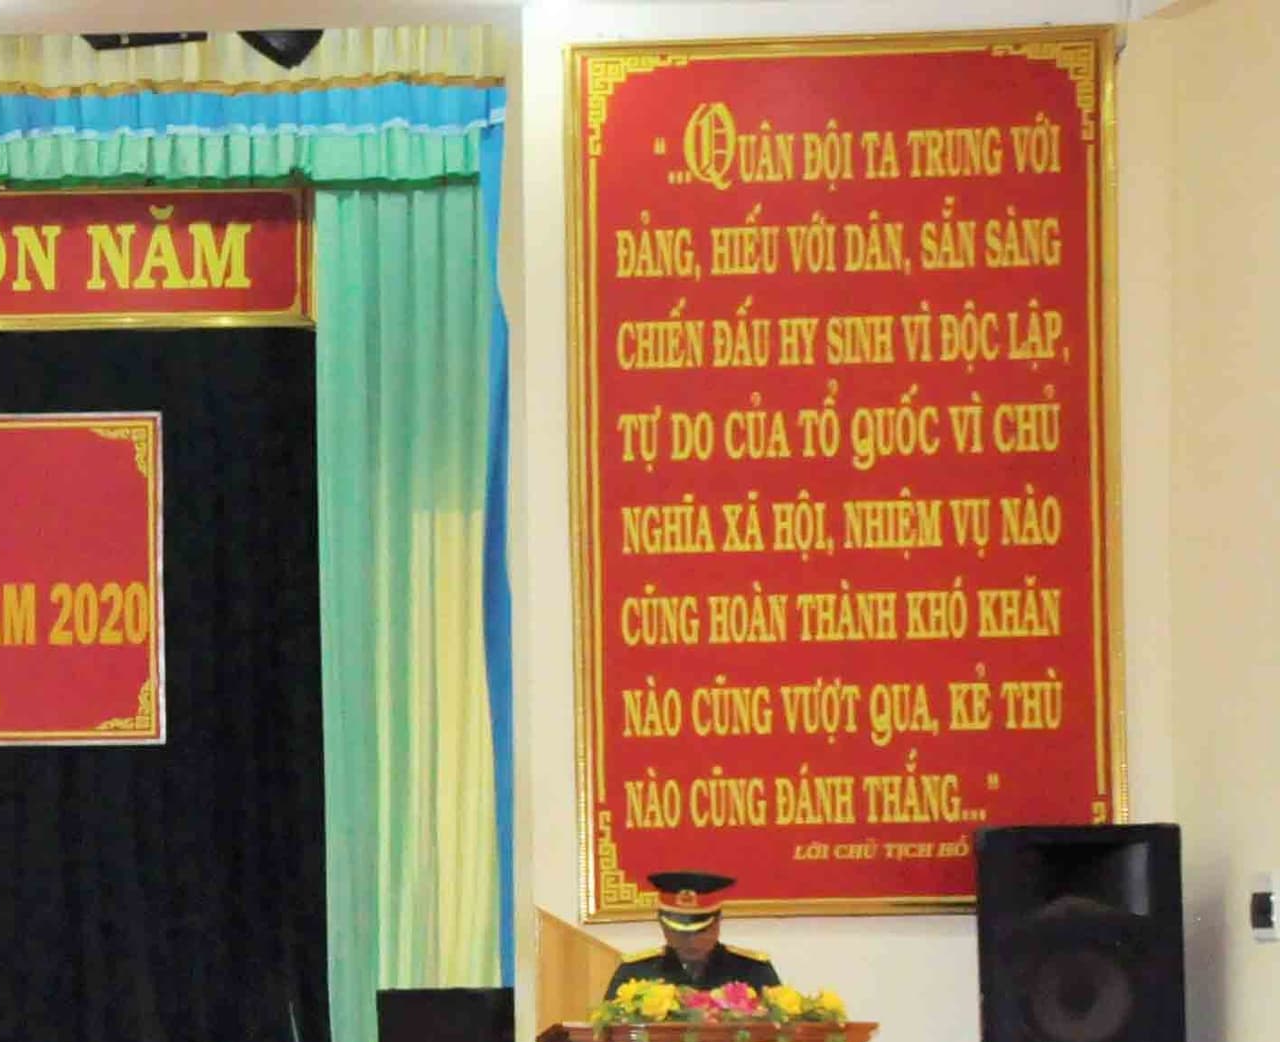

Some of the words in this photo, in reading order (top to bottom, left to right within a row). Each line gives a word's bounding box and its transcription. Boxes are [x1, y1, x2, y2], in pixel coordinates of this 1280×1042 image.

[803, 119, 853, 190] ĐỘI
[861, 132, 899, 179] TA
[908, 128, 1003, 177] TRUNG
[1010, 113, 1062, 175] VỚI
[86, 205, 252, 292] NĂM
[616, 210, 701, 281] ĐẢNG,
[710, 203, 779, 275] HIẾU
[787, 211, 836, 273] VỚI
[844, 210, 911, 275] DÂN,
[985, 205, 1062, 269] SÀNG
[616, 297, 704, 370] CHIẾN
[713, 295, 770, 368] ĐẤU
[779, 318, 819, 365] HY
[826, 315, 895, 365] SINH
[902, 300, 932, 362] VÌ
[940, 300, 1000, 372] ĐỘC
[618, 405, 662, 473] TỰ
[671, 412, 715, 462] DO
[725, 391, 791, 459] CỦA
[798, 379, 840, 458] TỔ
[851, 384, 940, 470] QUỐC
[949, 391, 984, 454] VÌ
[993, 384, 1061, 452] CHỦ
[622, 493, 715, 554] NGHĨA
[722, 491, 764, 552] XÃ
[773, 490, 834, 561] HỘI,
[844, 487, 943, 560] NHIỆM
[950, 499, 991, 558] VỤ
[1000, 484, 1062, 547] NÀO
[51, 583, 149, 645] 2020
[622, 584, 700, 646] CŨNG
[709, 581, 788, 644] HOÀN
[797, 579, 897, 642] THÀNH
[906, 576, 968, 639] KHÓ
[977, 576, 1062, 639] KHĂN
[622, 676, 683, 738] NÀO
[692, 675, 772, 736] CŨNG
[781, 677, 860, 744] VƯỢT
[870, 683, 939, 745] QUA,
[950, 663, 991, 730] KẺ
[1001, 668, 1063, 730] THÙ
[625, 768, 682, 829] NÀO
[690, 766, 766, 828] CŨNG
[776, 764, 855, 826] ĐÁNH
